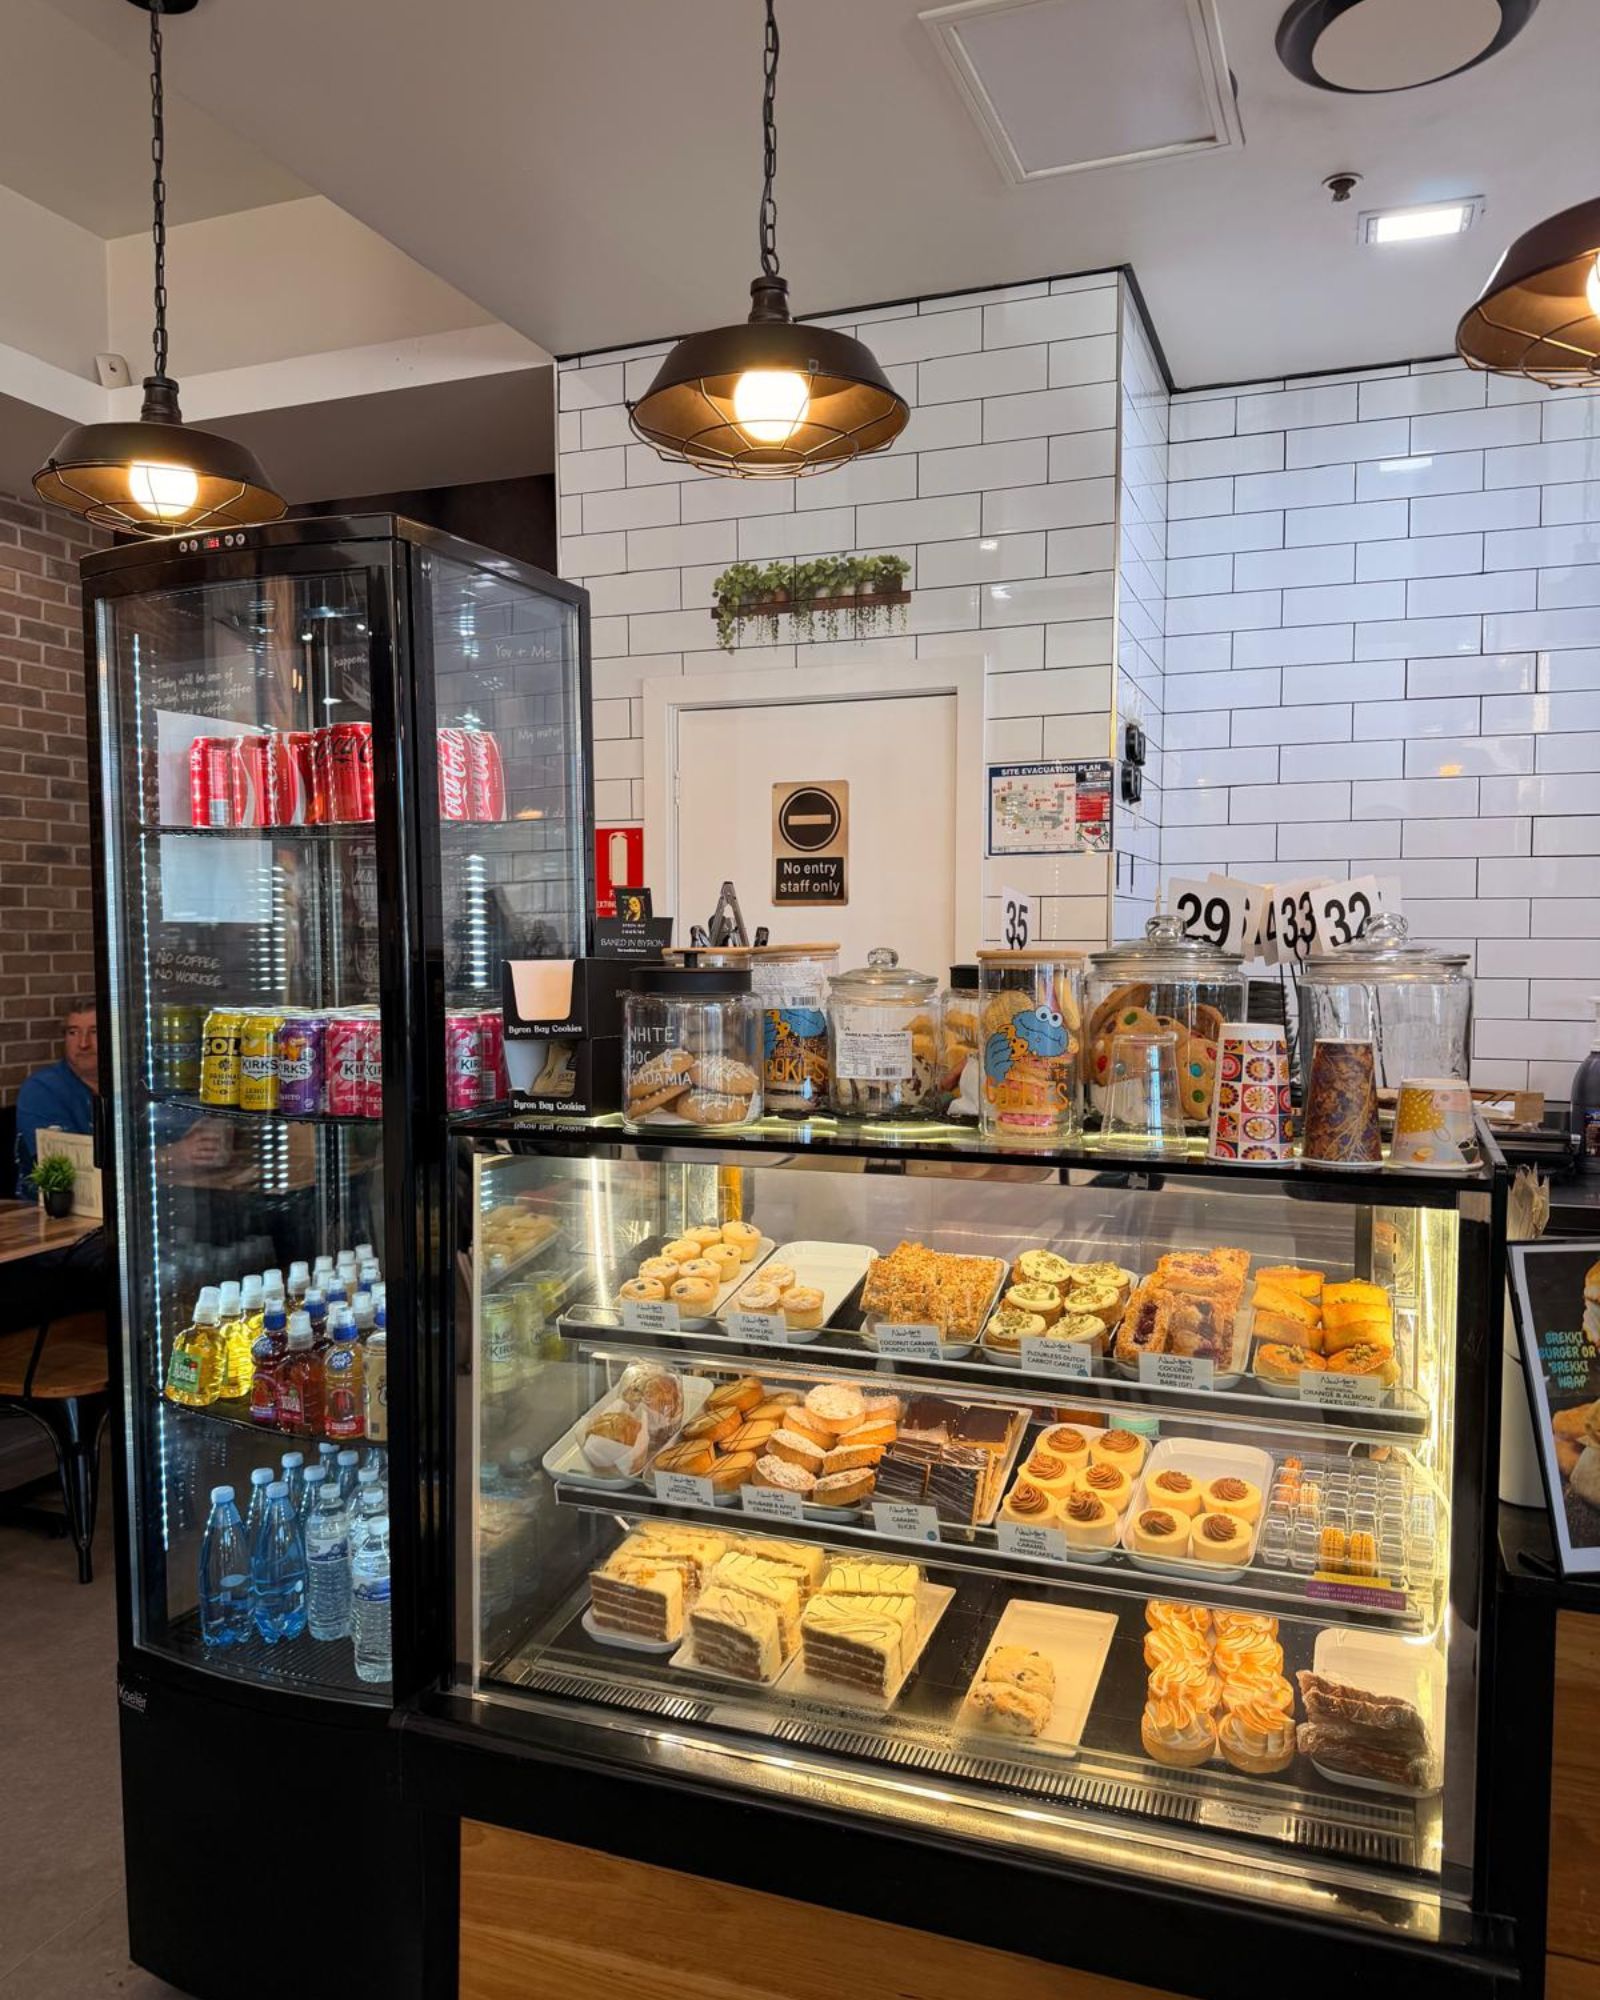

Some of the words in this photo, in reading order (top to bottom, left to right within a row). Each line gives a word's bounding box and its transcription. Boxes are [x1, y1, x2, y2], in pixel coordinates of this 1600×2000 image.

[1001, 768, 1020, 777] SITE
[1021, 764, 1076, 776] EVACUATION
[1078, 763, 1101, 772] PLAN
[783, 861, 801, 875] No
[803, 863, 837, 879] entry
[779, 879, 810, 893] staff
[812, 879, 841, 897] only
[1005, 900, 1029, 950] 35
[1177, 892, 1231, 948] 29
[1281, 891, 1317, 949] 33
[1324, 891, 1372, 948] 32
[600, 938, 627, 947] BAKED
[637, 938, 665, 947] BYRON
[175, 952, 221, 969] COFFEE
[508, 1025, 532, 1034] Byron
[534, 1025, 550, 1034] Bay
[551, 1024, 583, 1033] Cookies
[204, 1038, 238, 1056] SOL
[242, 1056, 278, 1071] KIRKS
[278, 1062, 308, 1076] IRKS
[365, 1064, 382, 1075] KIR
[460, 1058, 481, 1071] KIR
[514, 1101, 537, 1111] Byron
[539, 1101, 554, 1111] Bay
[556, 1100, 587, 1111] Cookies
[1545, 1331, 1583, 1347] BREKKI
[1026, 1350, 1062, 1359] FLOURLESS
[1536, 1346, 1580, 1359] BURGER
[1581, 1345, 1597, 1358] OR
[1027, 1357, 1053, 1365] CARROT
[1053, 1360, 1071, 1368] CAKE
[1158, 1364, 1193, 1374] COCONUT
[1157, 1372, 1195, 1381] RASPBERRY
[1557, 1374, 1587, 1390] WRAP
[1303, 1389, 1334, 1398] ORANGE
[1342, 1393, 1377, 1402] ALMOND
[1319, 1398, 1343, 1406] CAKES
[891, 1516, 921, 1524] CARAMEL
